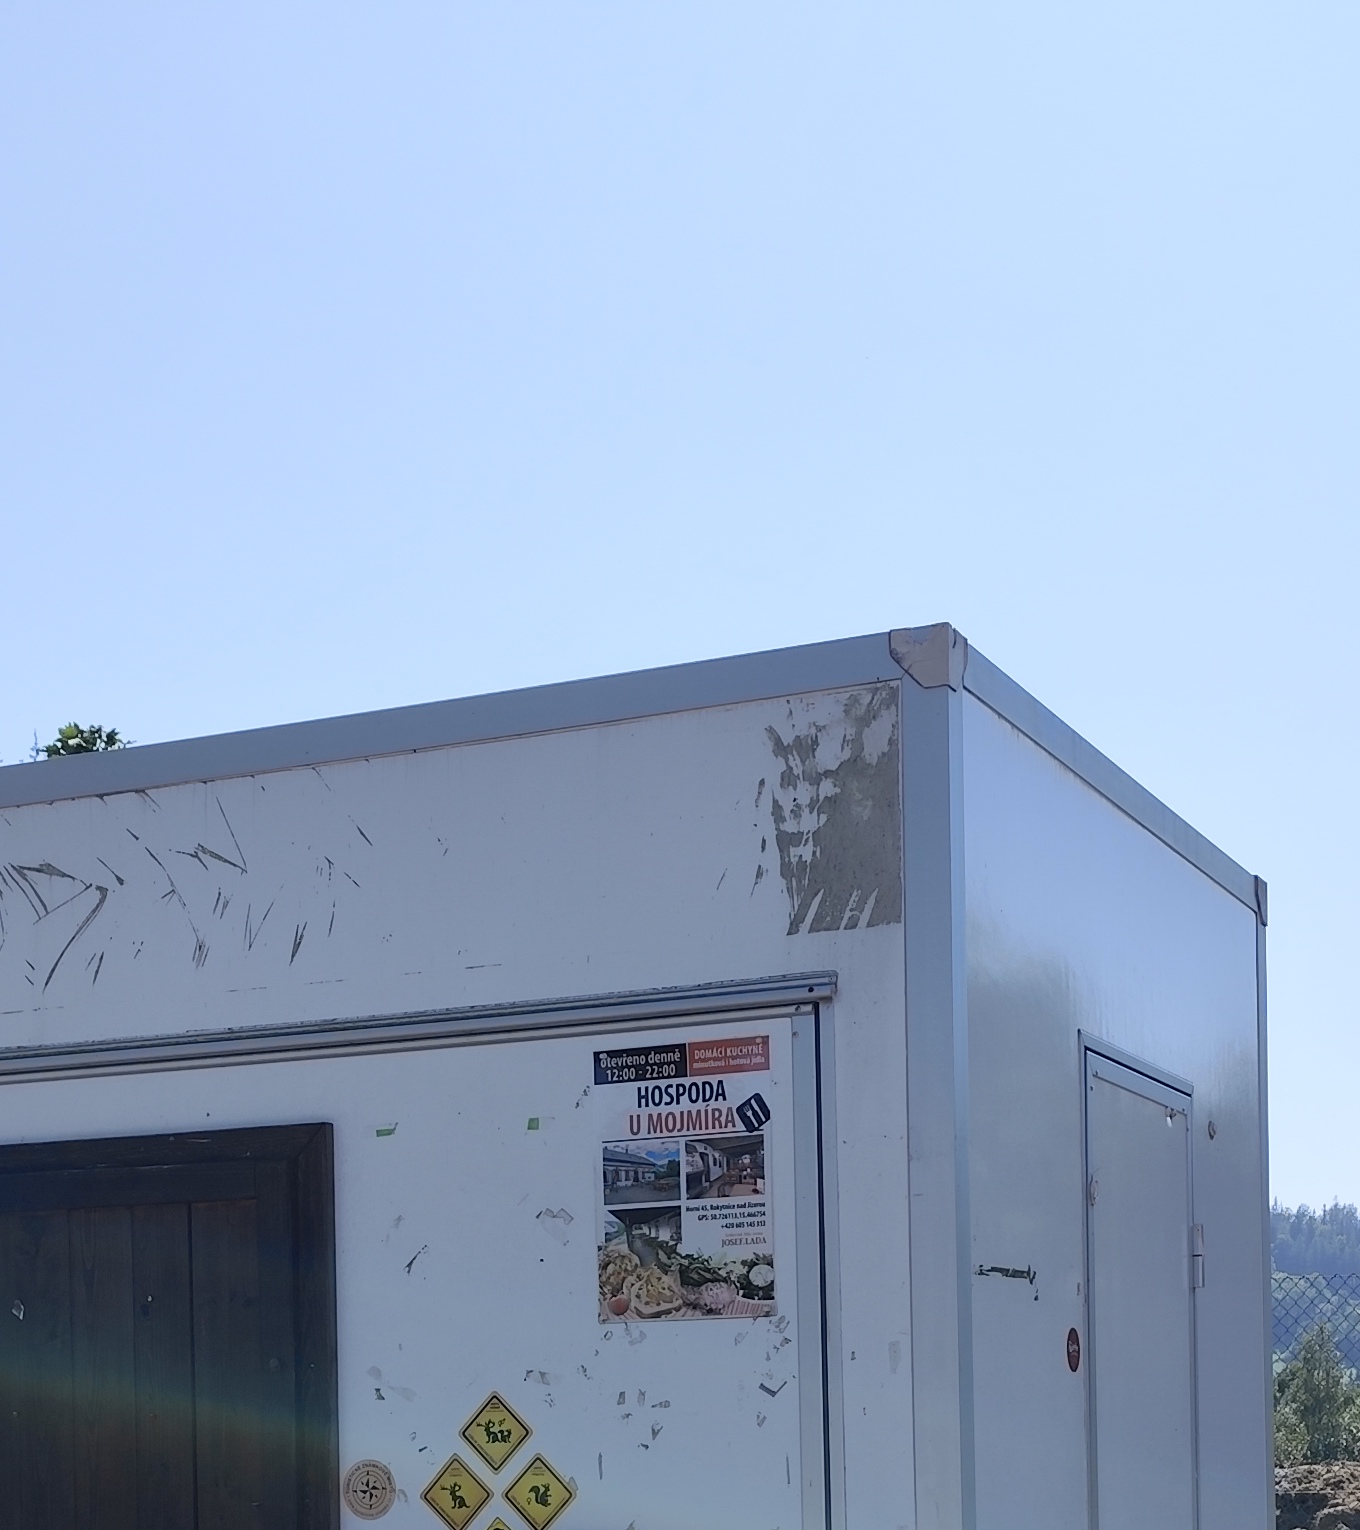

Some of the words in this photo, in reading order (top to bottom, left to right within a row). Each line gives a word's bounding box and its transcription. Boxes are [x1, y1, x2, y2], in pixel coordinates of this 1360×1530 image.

[648, 1048, 681, 1064] denně
[694, 1046, 725, 1059] DOMÁCÍ
[606, 1067, 636, 1082] 12:00
[645, 1063, 676, 1078] 22:00
[637, 1079, 727, 1109] HOSPODA
[629, 1113, 641, 1136] U
[647, 1104, 737, 1135] MOJMÍRA
